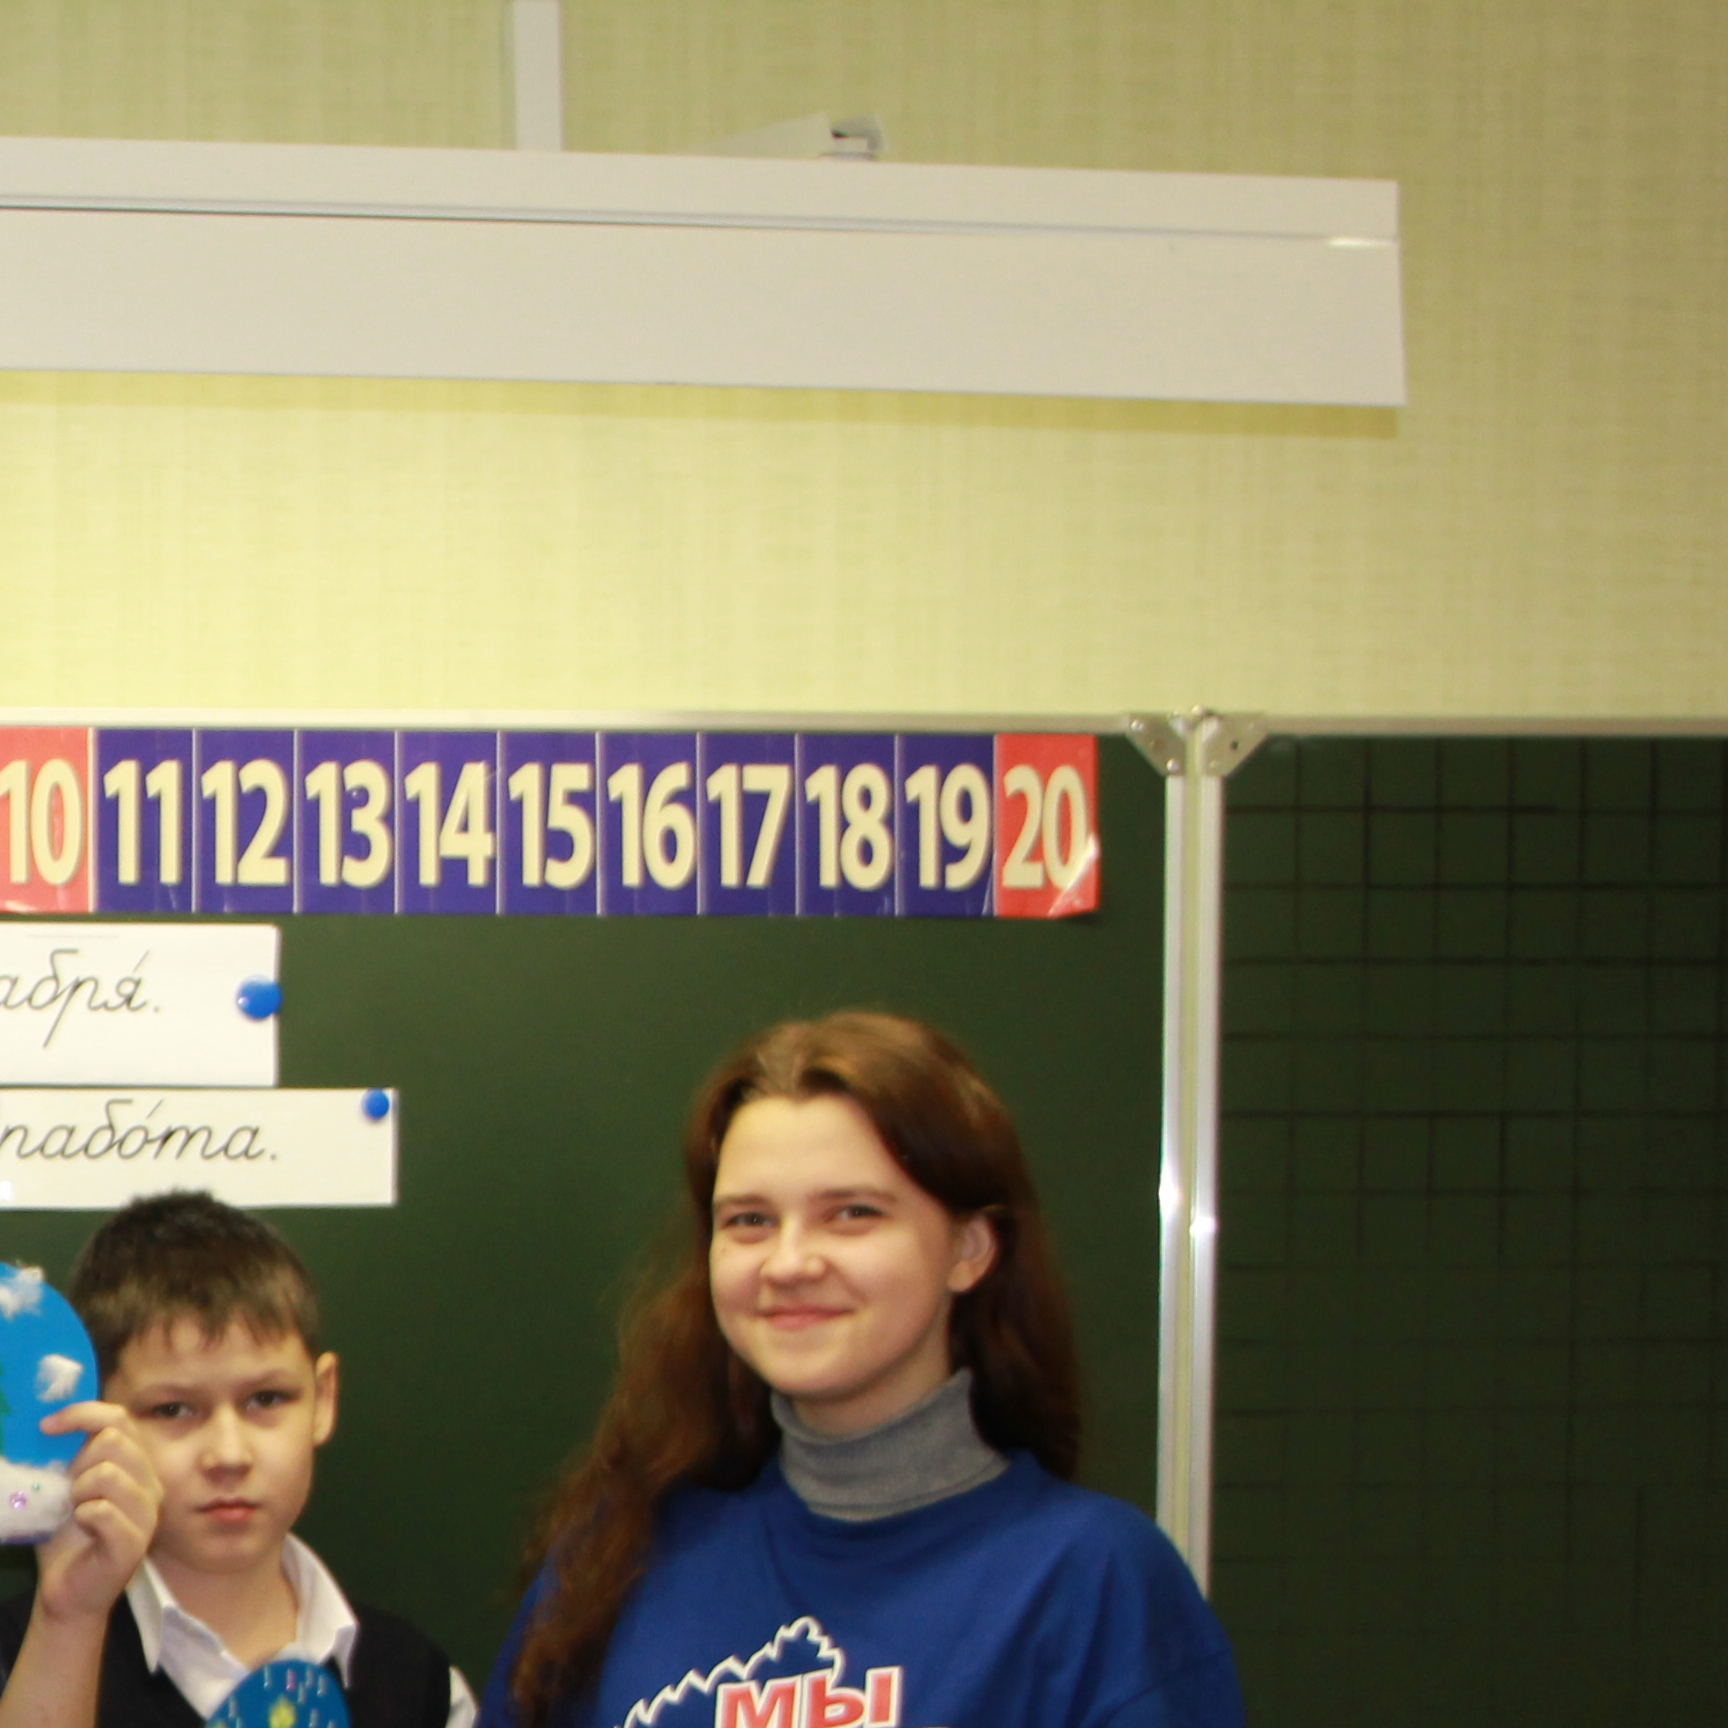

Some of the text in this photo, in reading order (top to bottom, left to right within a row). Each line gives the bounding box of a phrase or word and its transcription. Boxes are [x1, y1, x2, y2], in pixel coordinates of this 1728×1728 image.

[103, 759, 182, 885] 11
[201, 759, 291, 887] 12
[305, 759, 393, 888] 13
[404, 760, 496, 888] 14
[508, 762, 595, 890] 15
[607, 761, 696, 890] 16
[706, 763, 792, 888] 17
[805, 763, 893, 891] 18
[904, 763, 991, 891] 19
[1002, 764, 1089, 891] 20
